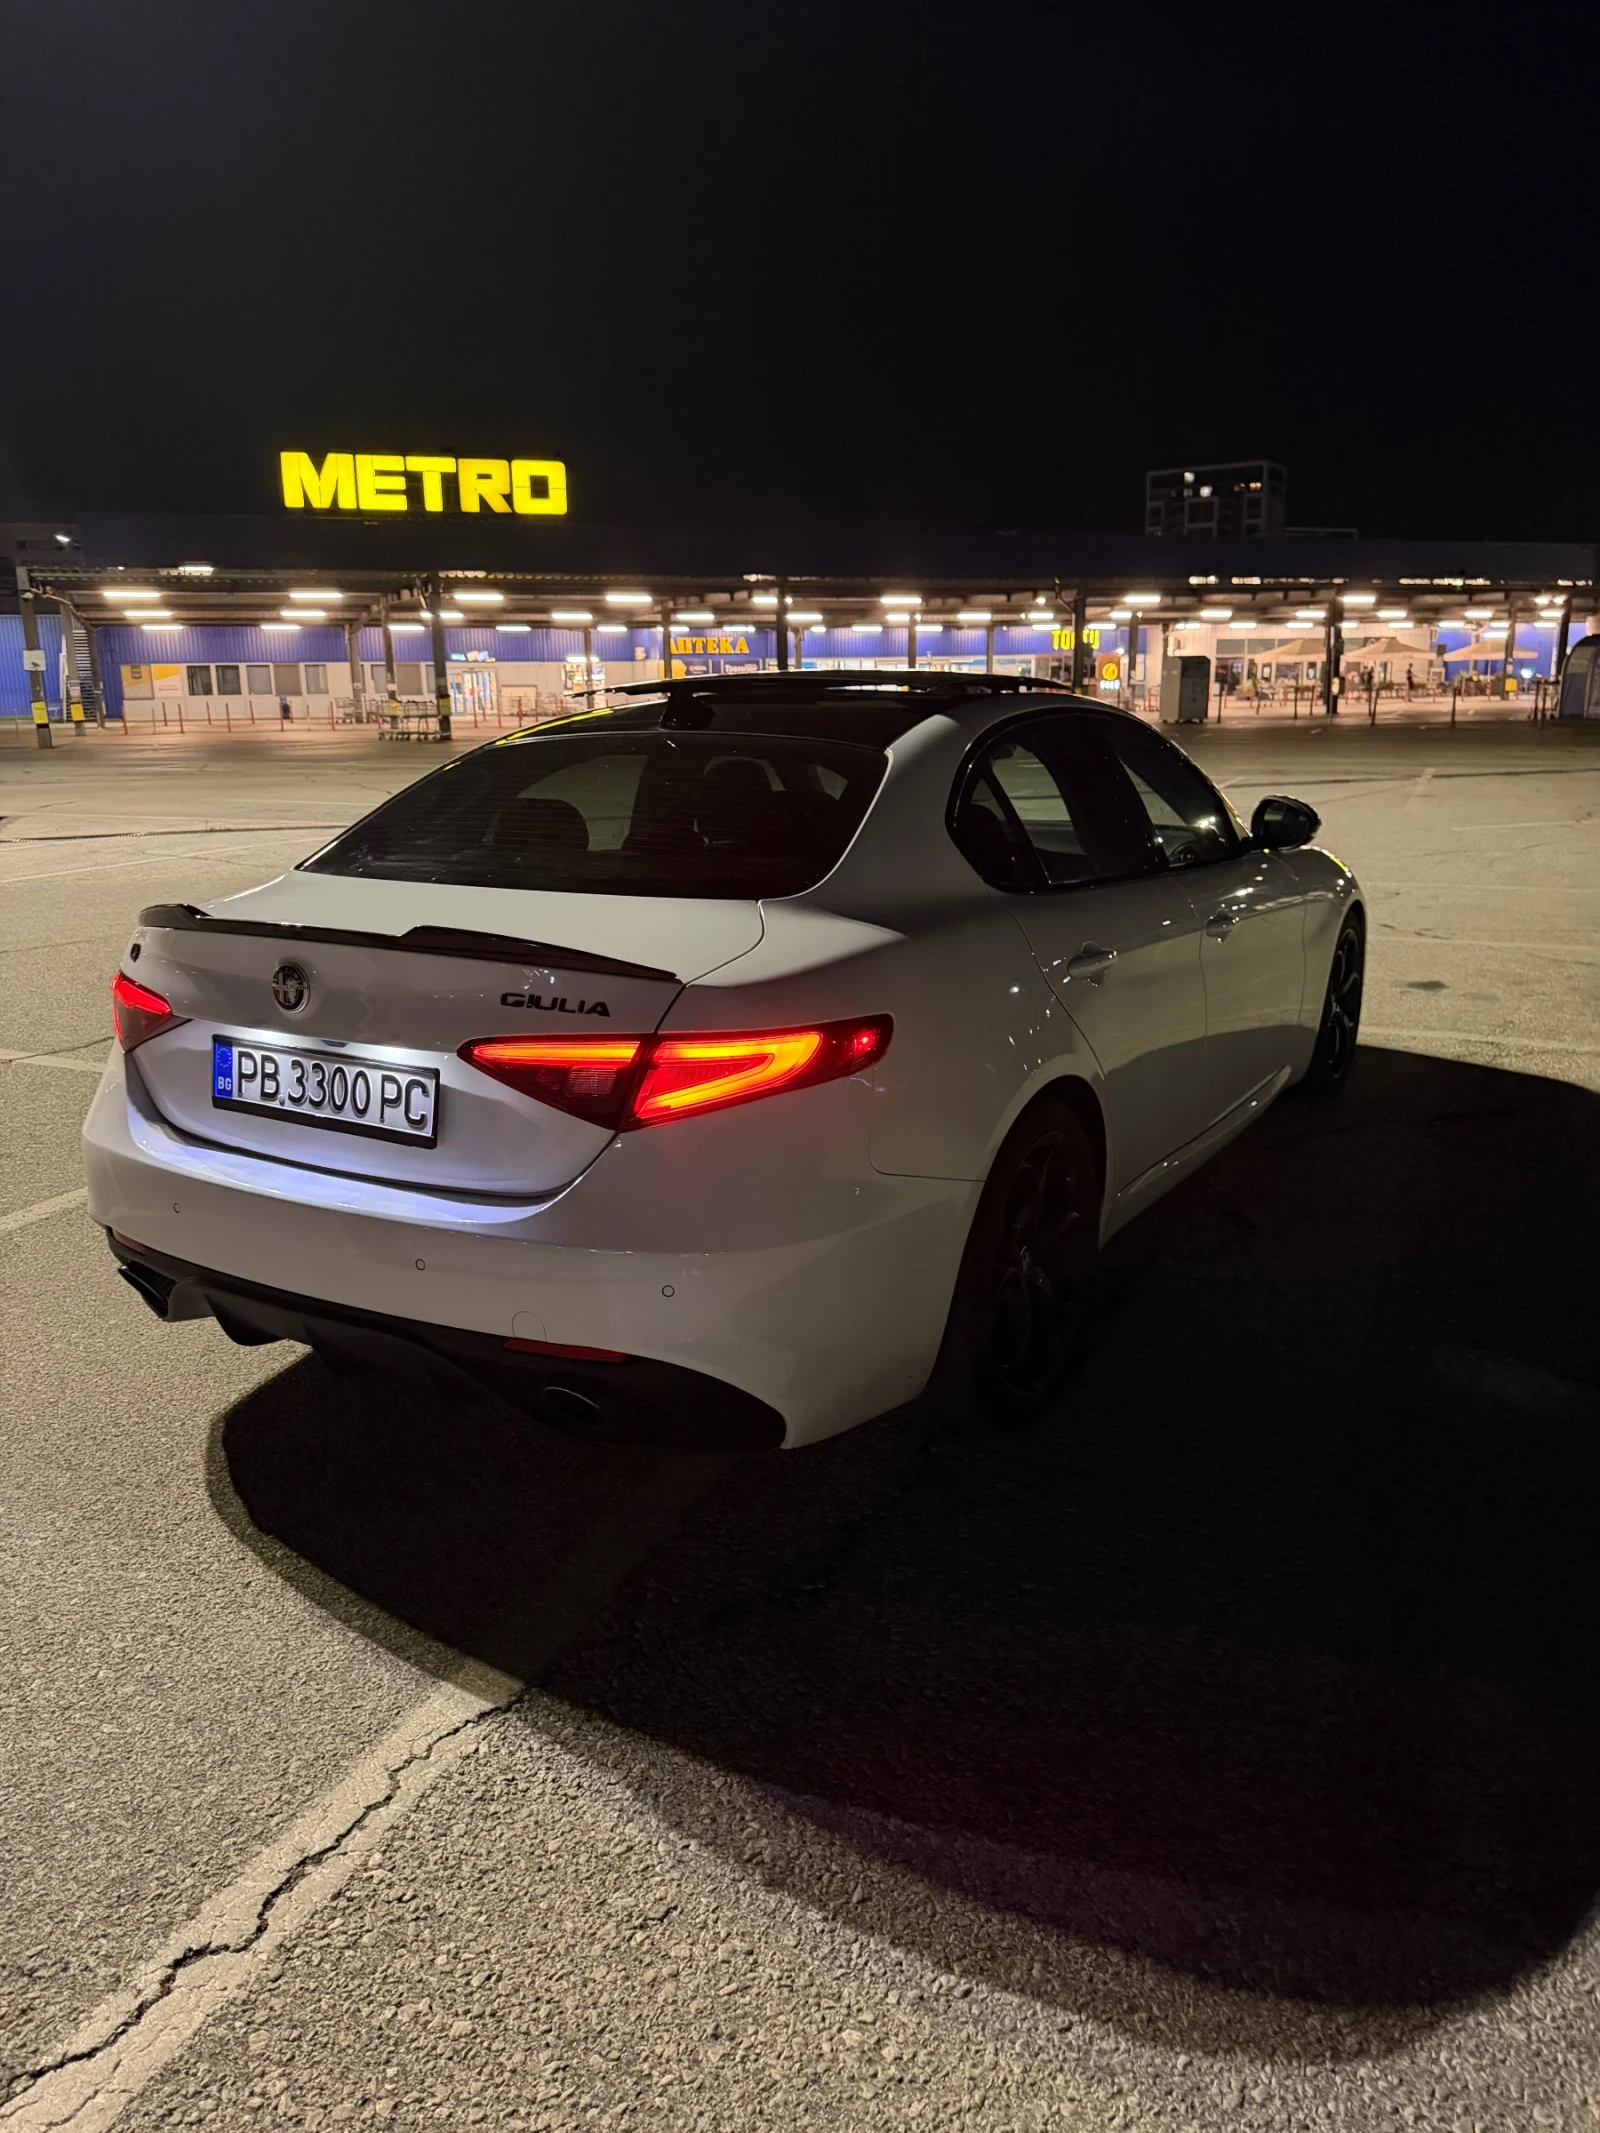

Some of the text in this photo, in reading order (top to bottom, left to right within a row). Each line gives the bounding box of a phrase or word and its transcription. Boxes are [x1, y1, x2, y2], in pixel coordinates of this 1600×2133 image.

[280, 452, 567, 514] METRO
[501, 993, 611, 1017] GIULIA
[218, 1077, 232, 1091] BG
